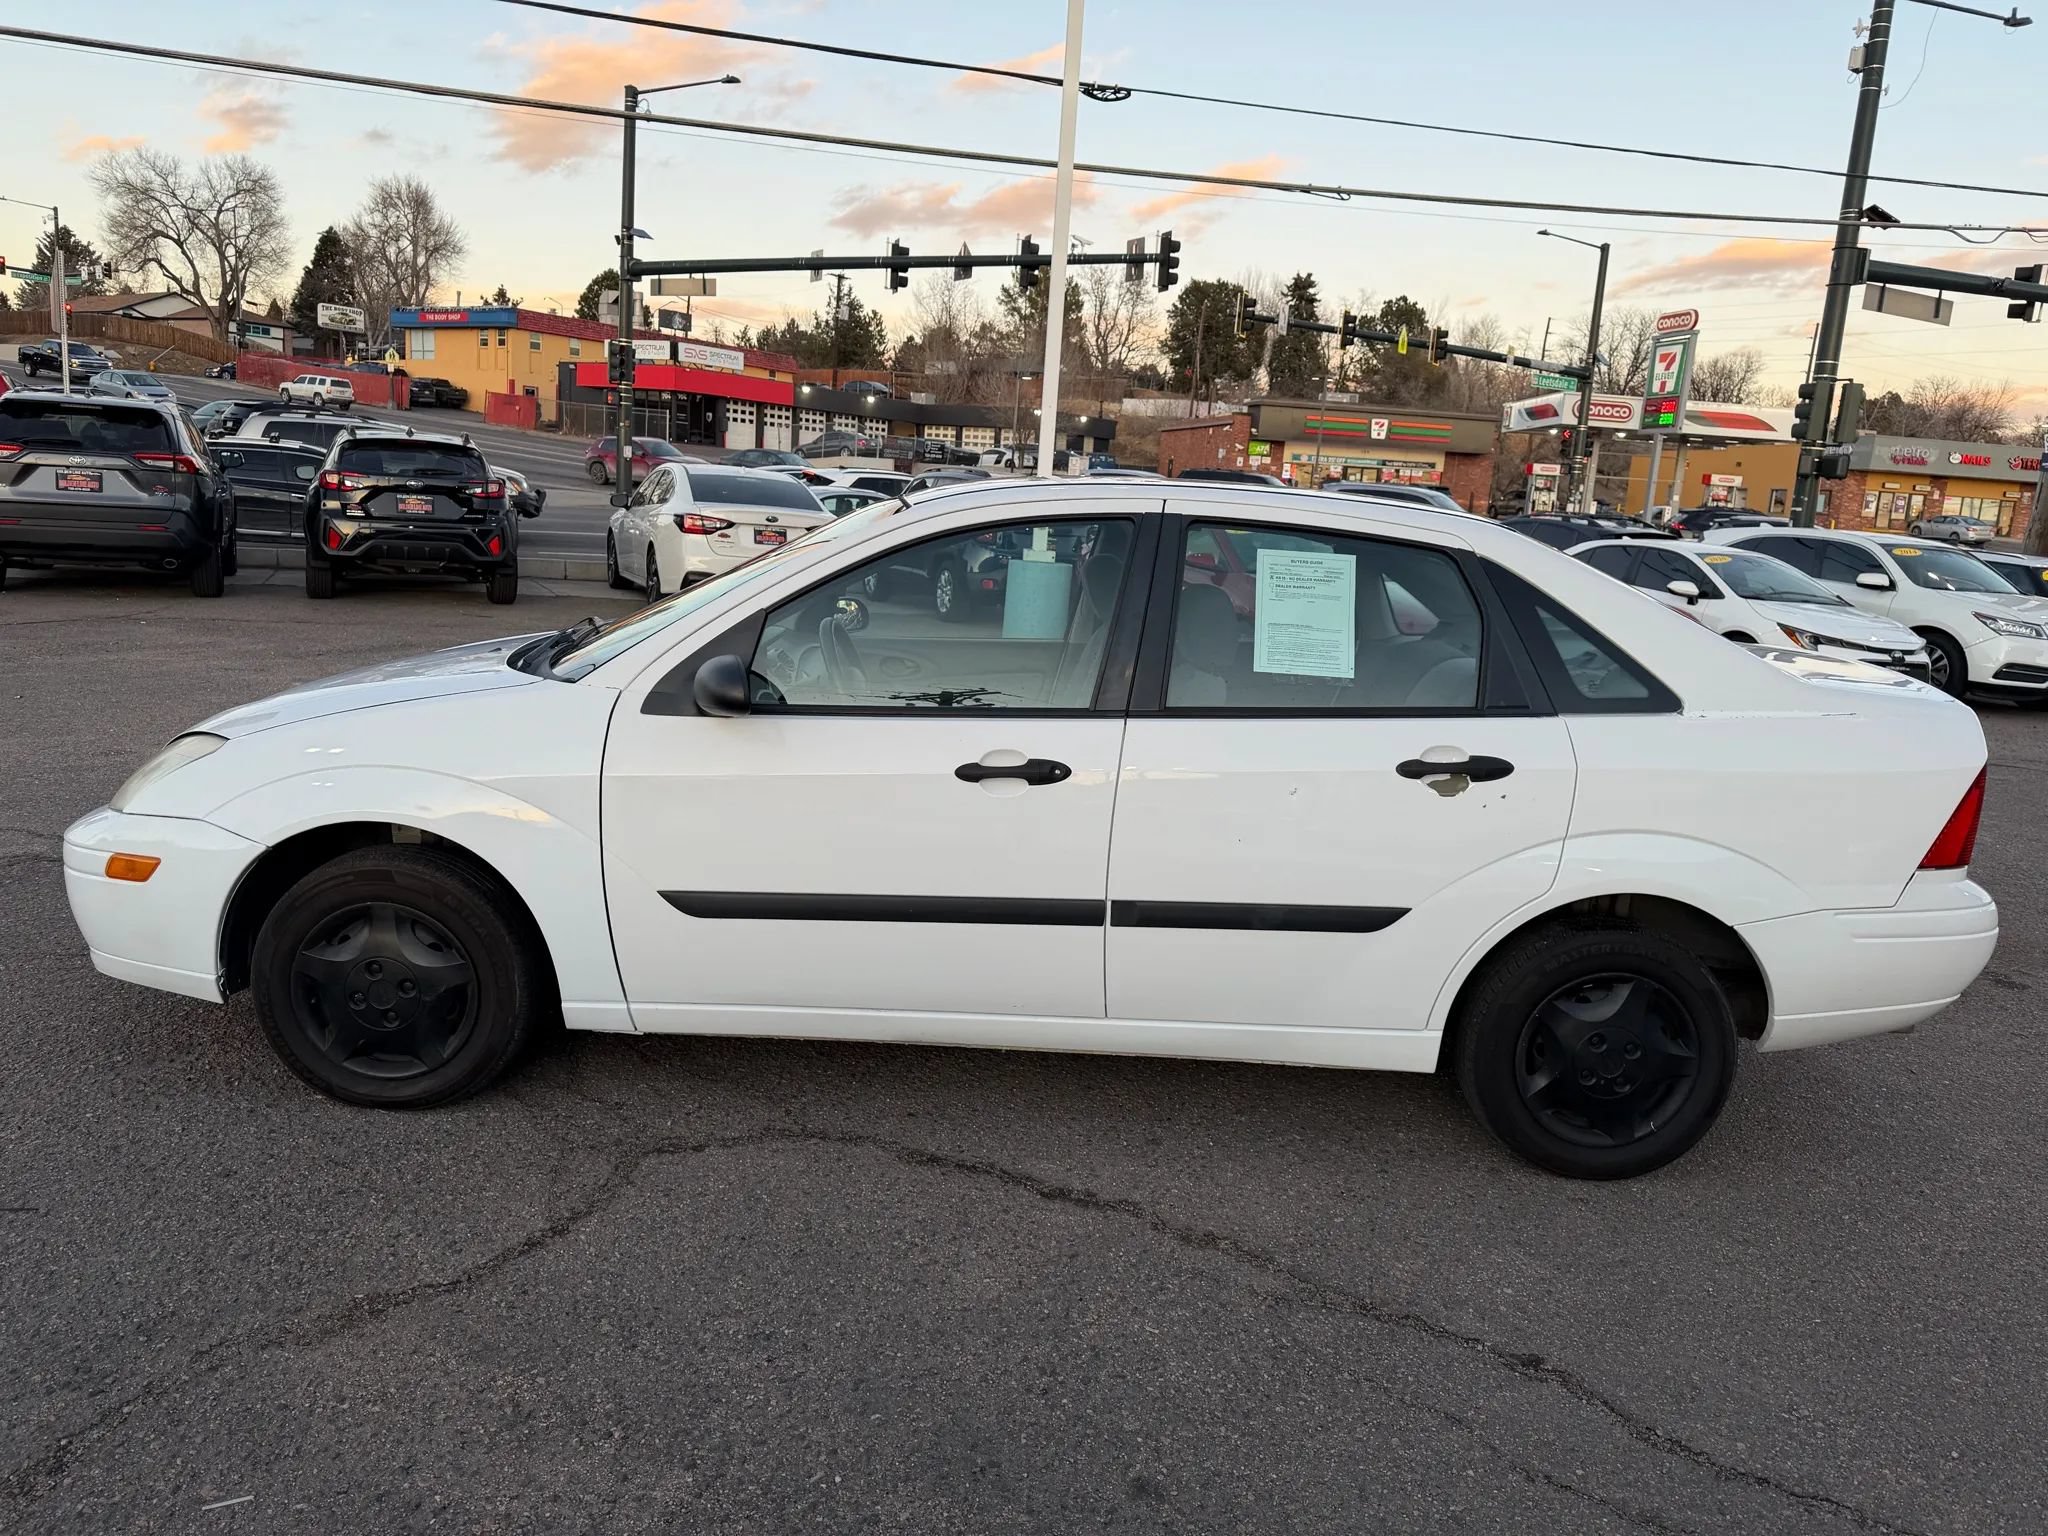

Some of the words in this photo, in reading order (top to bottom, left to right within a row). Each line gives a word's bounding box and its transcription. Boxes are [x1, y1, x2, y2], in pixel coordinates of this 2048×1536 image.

[348, 308, 363, 317] SHOP
[709, 351, 738, 361] SPECTRUM
[1539, 376, 1569, 388] Leetsdale
[1589, 405, 1630, 417] onoco
[1890, 445, 1930, 457] metro
[1961, 454, 1991, 467] NAILS
